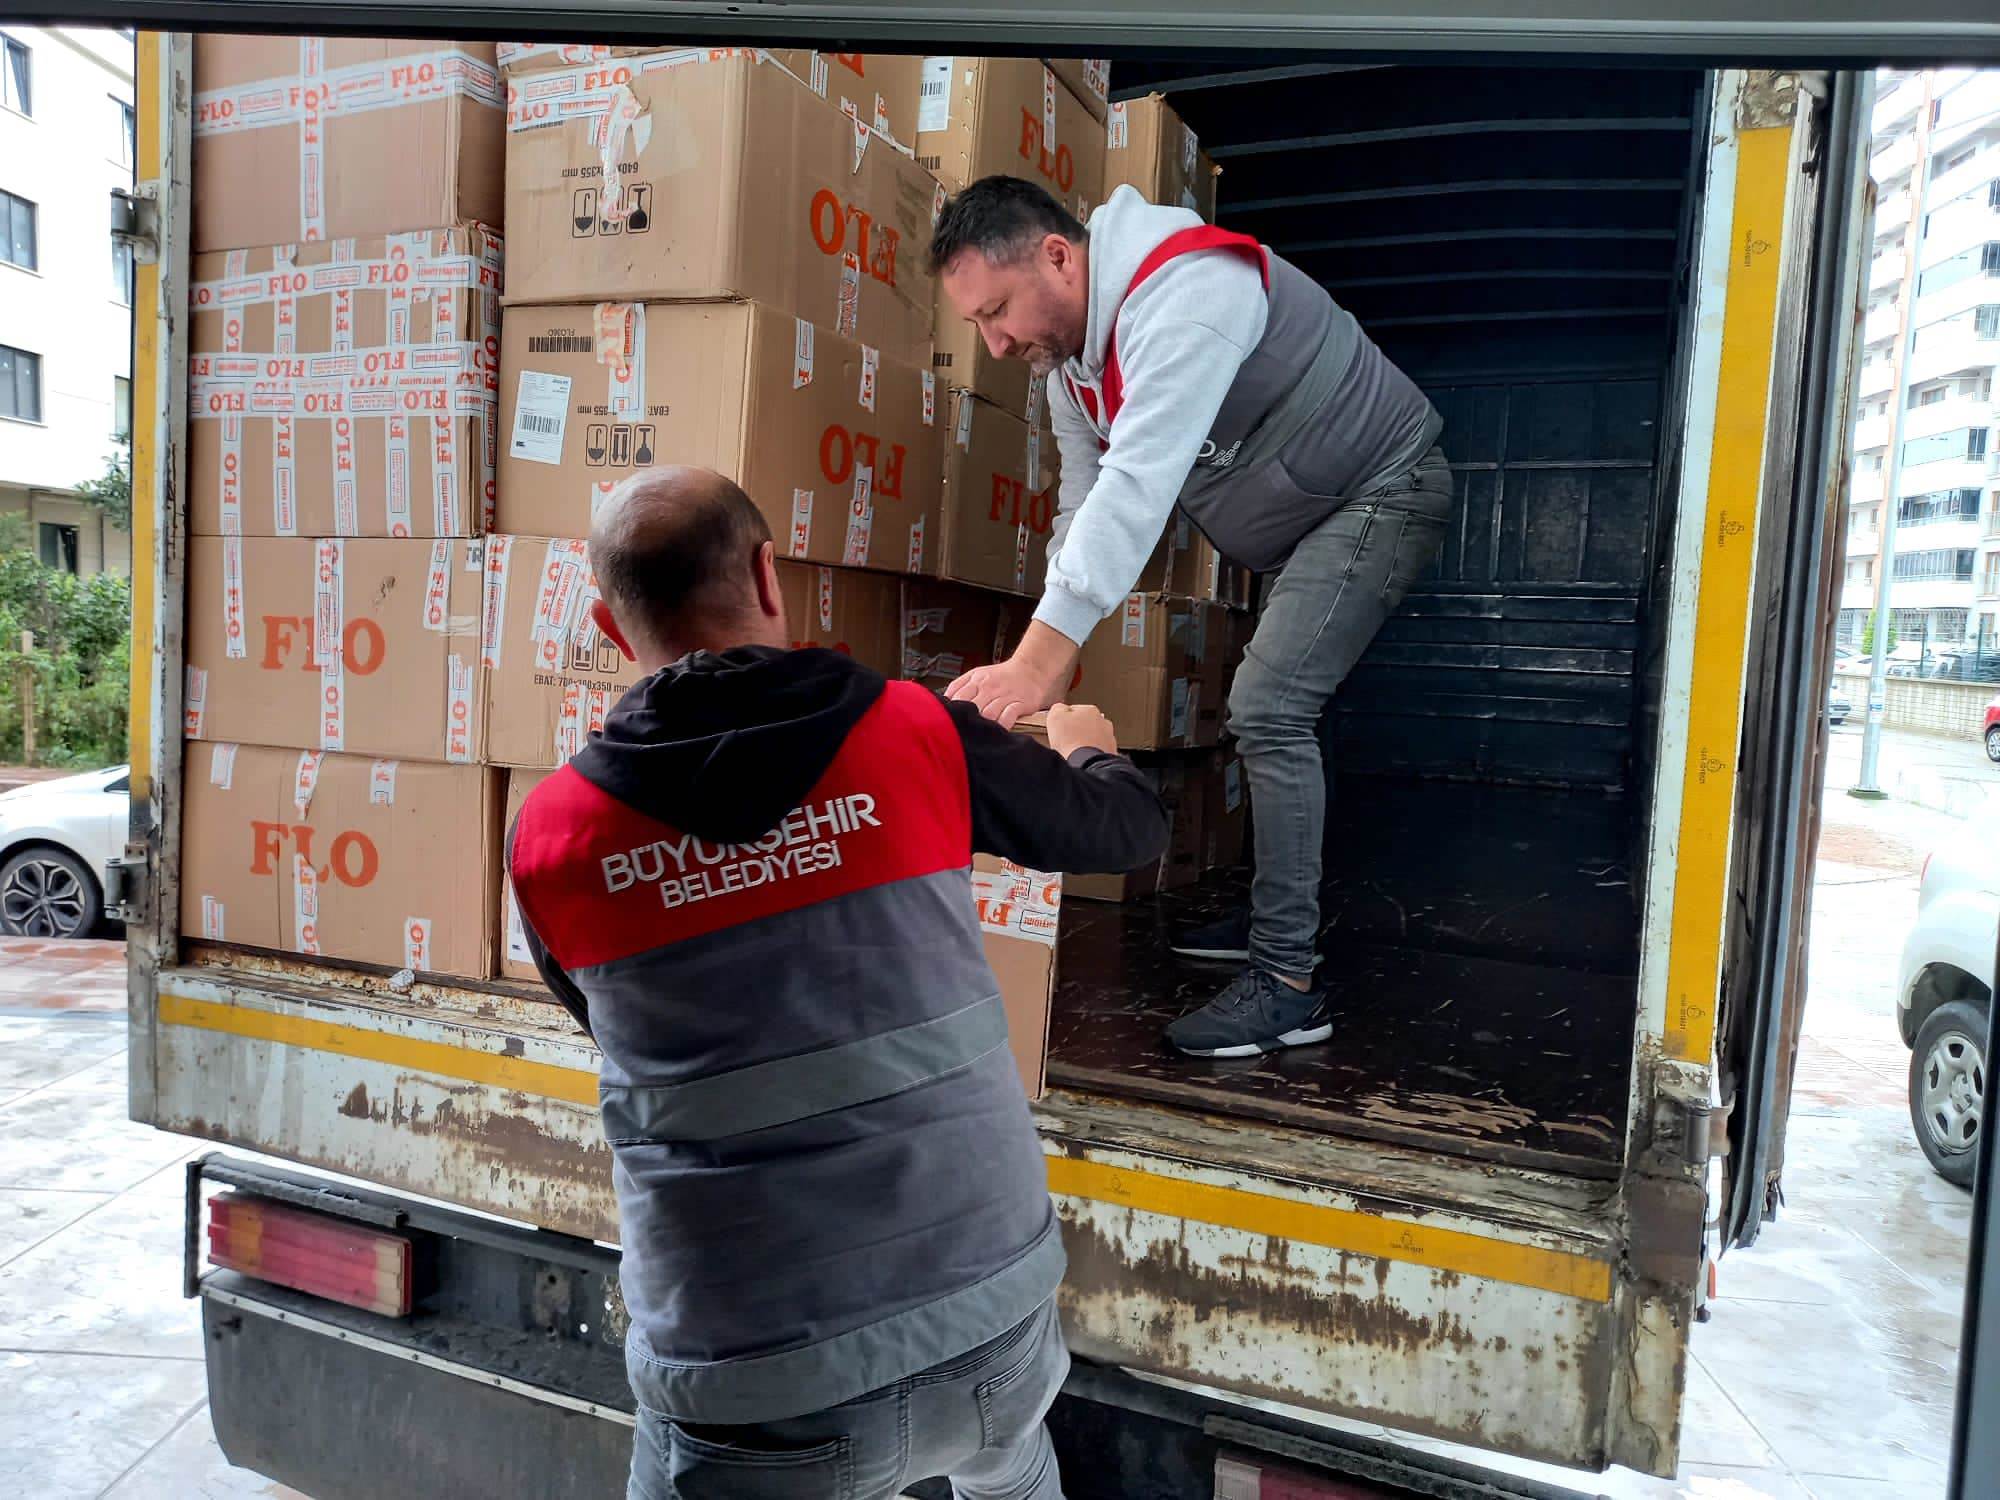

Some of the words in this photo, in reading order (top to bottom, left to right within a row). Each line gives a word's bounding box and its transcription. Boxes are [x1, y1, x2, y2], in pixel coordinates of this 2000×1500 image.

[392, 63, 434, 88] FLO
[583, 67, 632, 90] FLO
[200, 99, 234, 122] FLO
[304, 90, 320, 144] FLO
[1018, 105, 1073, 192] FLO
[810, 188, 900, 287] FLO
[268, 272, 307, 295] FLO
[367, 263, 410, 284] FLO
[279, 298, 293, 327] FL
[438, 287, 451, 321] FL
[226, 319, 241, 352] LO
[192, 358, 210, 376] FL
[267, 360, 305, 377] FLO
[364, 351, 406, 372] FLO
[485, 336, 499, 391] FLO
[210, 393, 245, 412] FLO
[304, 393, 343, 412] FLO
[404, 390, 448, 410] FLO
[337, 417, 351, 471] FLO
[390, 415, 404, 441] FL
[224, 453, 237, 504] FLO
[819, 424, 906, 500] FLO
[989, 472, 1051, 534] FLO
[227, 587, 241, 638] FLO
[428, 570, 445, 625] FLO
[1128, 595, 1141, 619] FL
[325, 686, 339, 738] FLO
[451, 700, 467, 755] FLO
[250, 821, 379, 888] FLO
[659, 840, 842, 908] BELEDİYESİ
